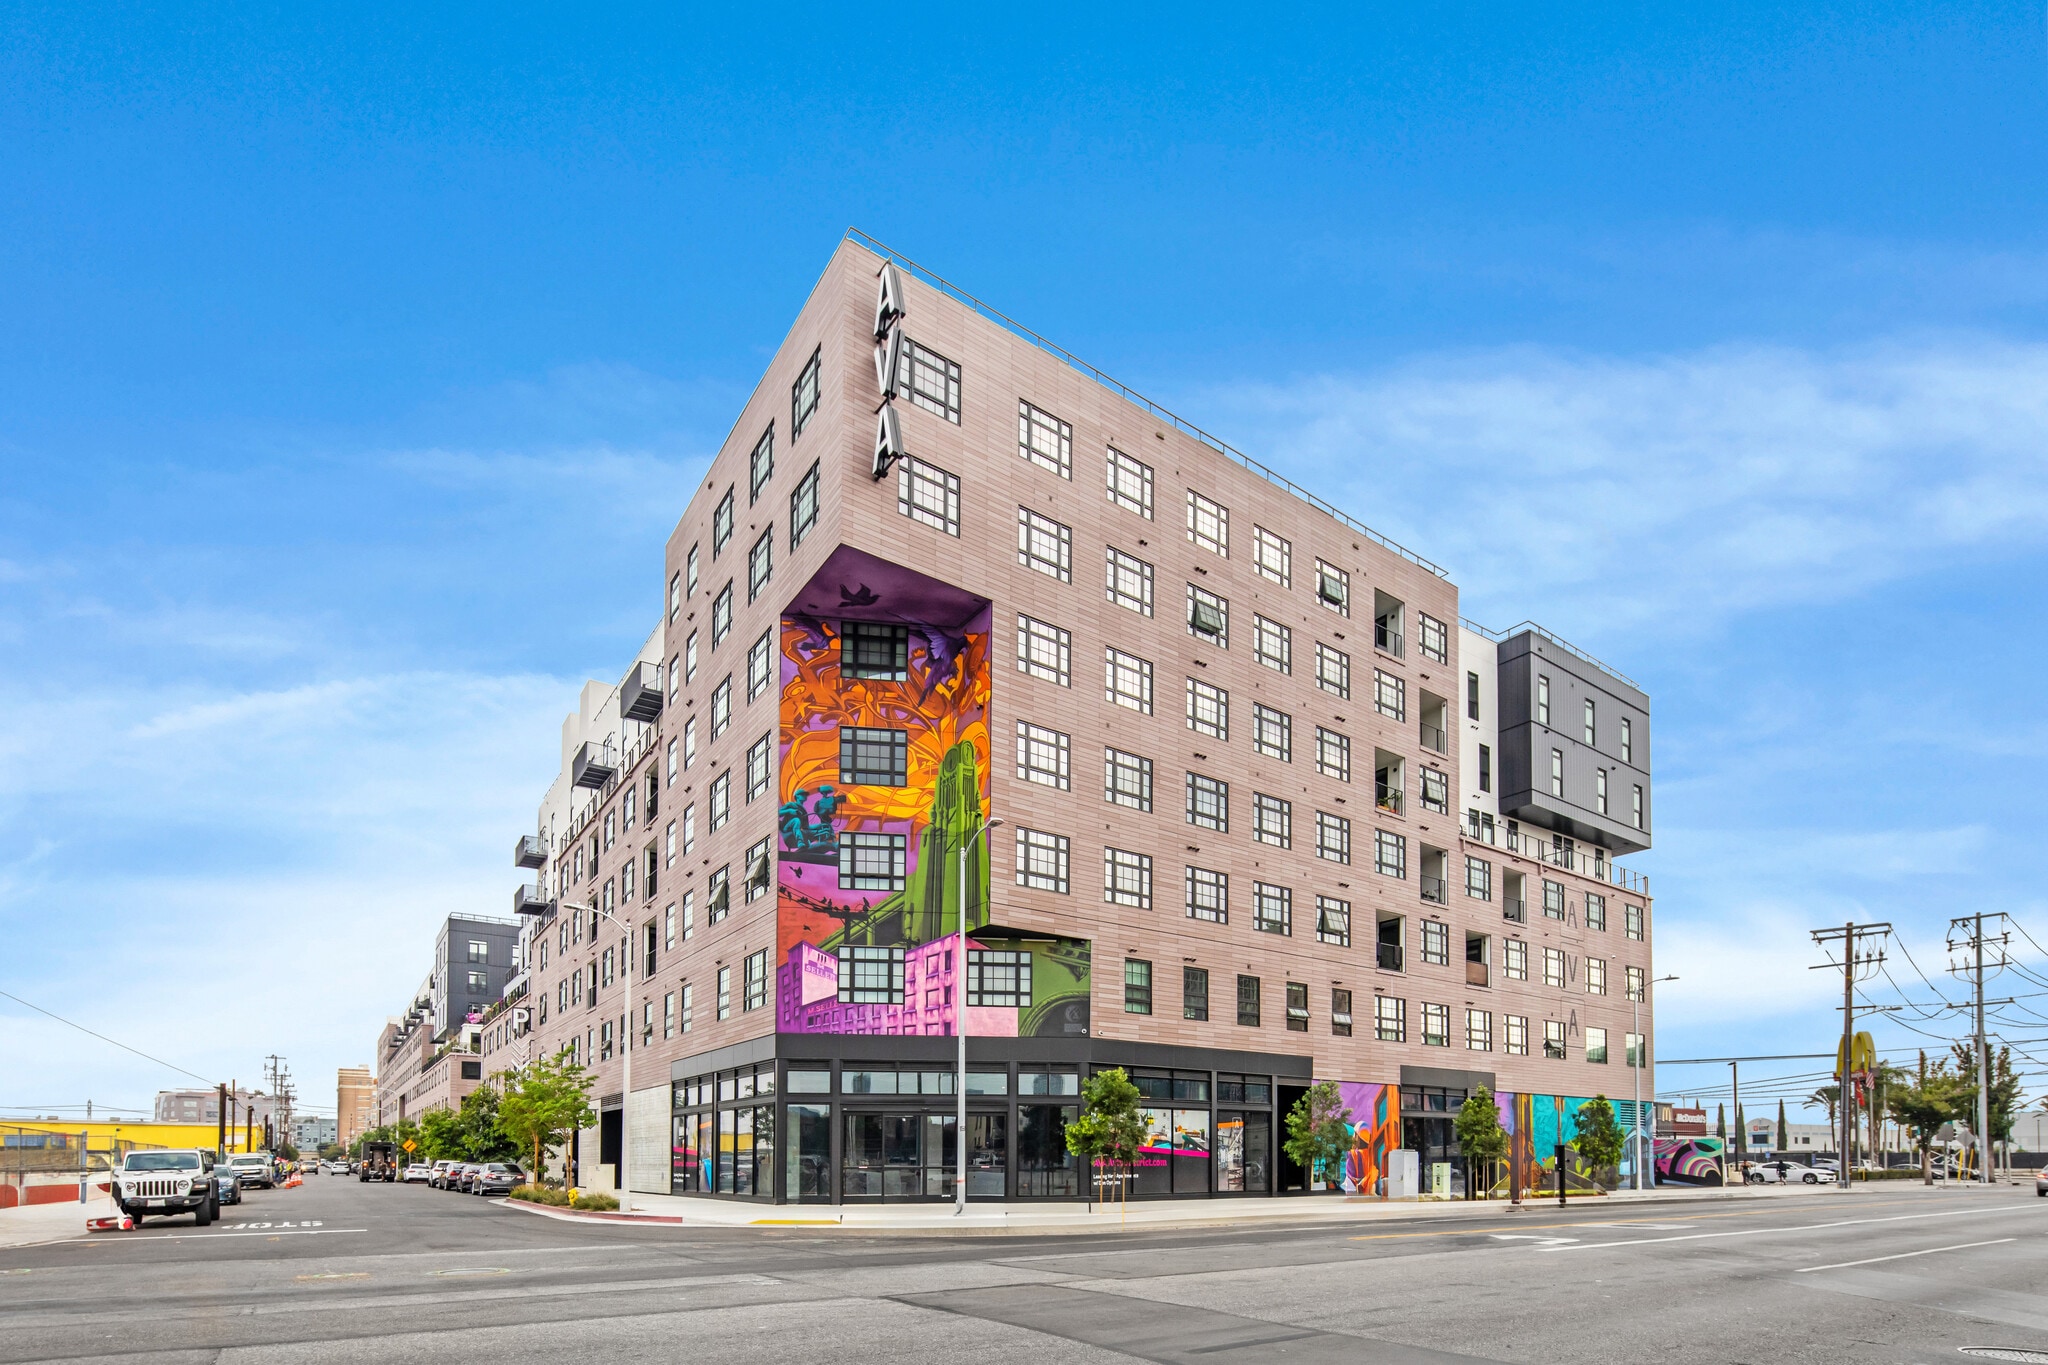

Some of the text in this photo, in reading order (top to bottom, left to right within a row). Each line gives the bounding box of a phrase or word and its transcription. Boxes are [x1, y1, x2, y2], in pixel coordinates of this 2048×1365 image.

[872, 264, 906, 479] AVA
[1567, 900, 1579, 1037] AVA
[512, 1008, 529, 1034] P
[221, 1221, 323, 1229] STOP
